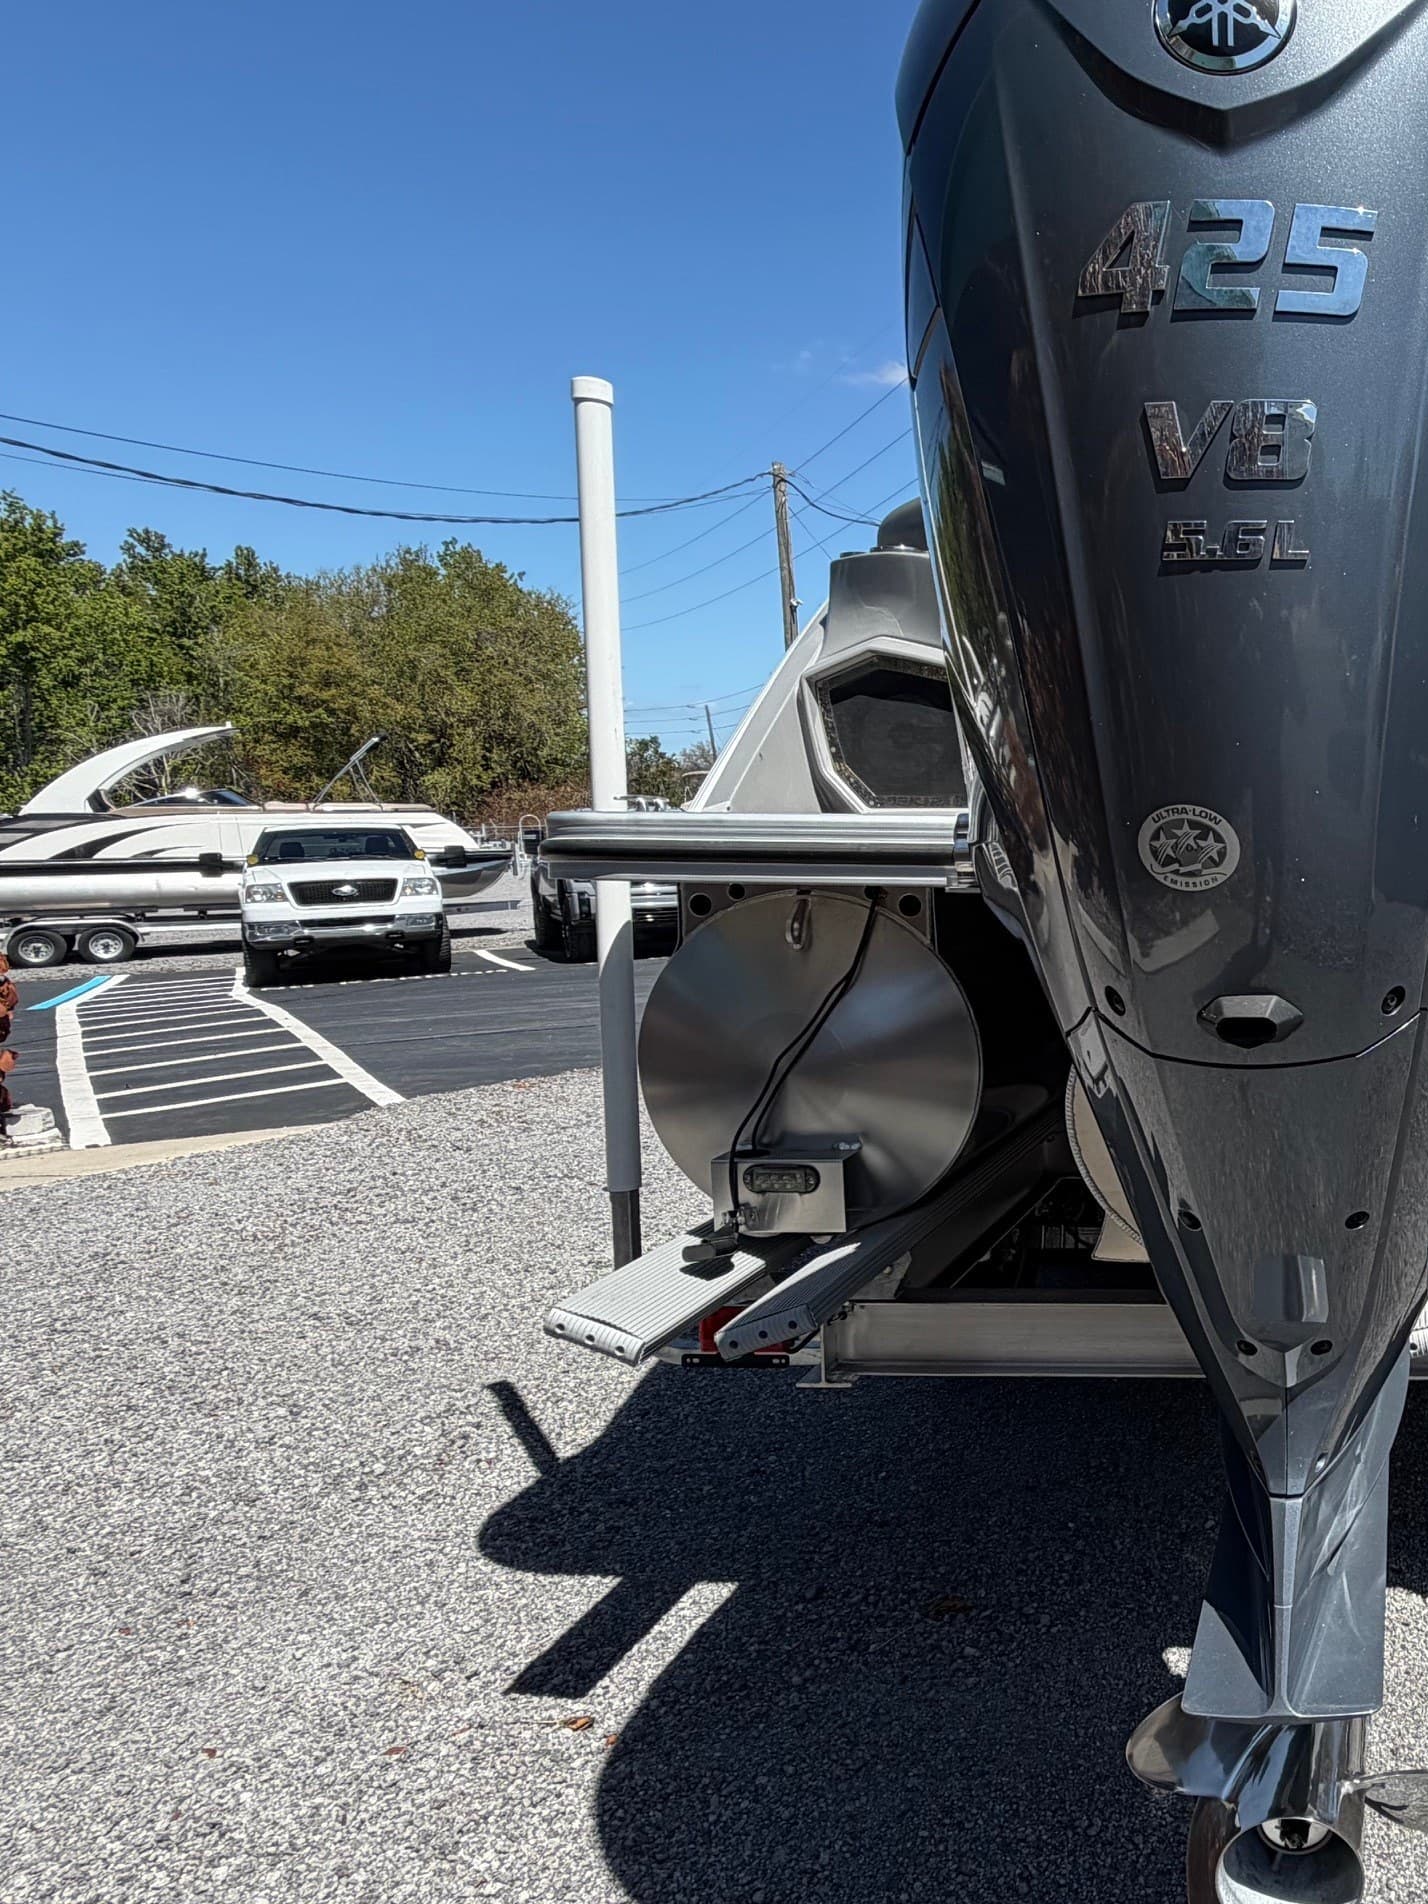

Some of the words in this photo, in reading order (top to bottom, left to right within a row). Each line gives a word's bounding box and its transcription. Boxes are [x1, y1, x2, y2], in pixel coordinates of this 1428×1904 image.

[1077, 198, 1379, 317] 425
[1143, 399, 1319, 480] V8
[1162, 519, 1311, 562] 5.6L
[1163, 875, 1219, 888] EMISSION
